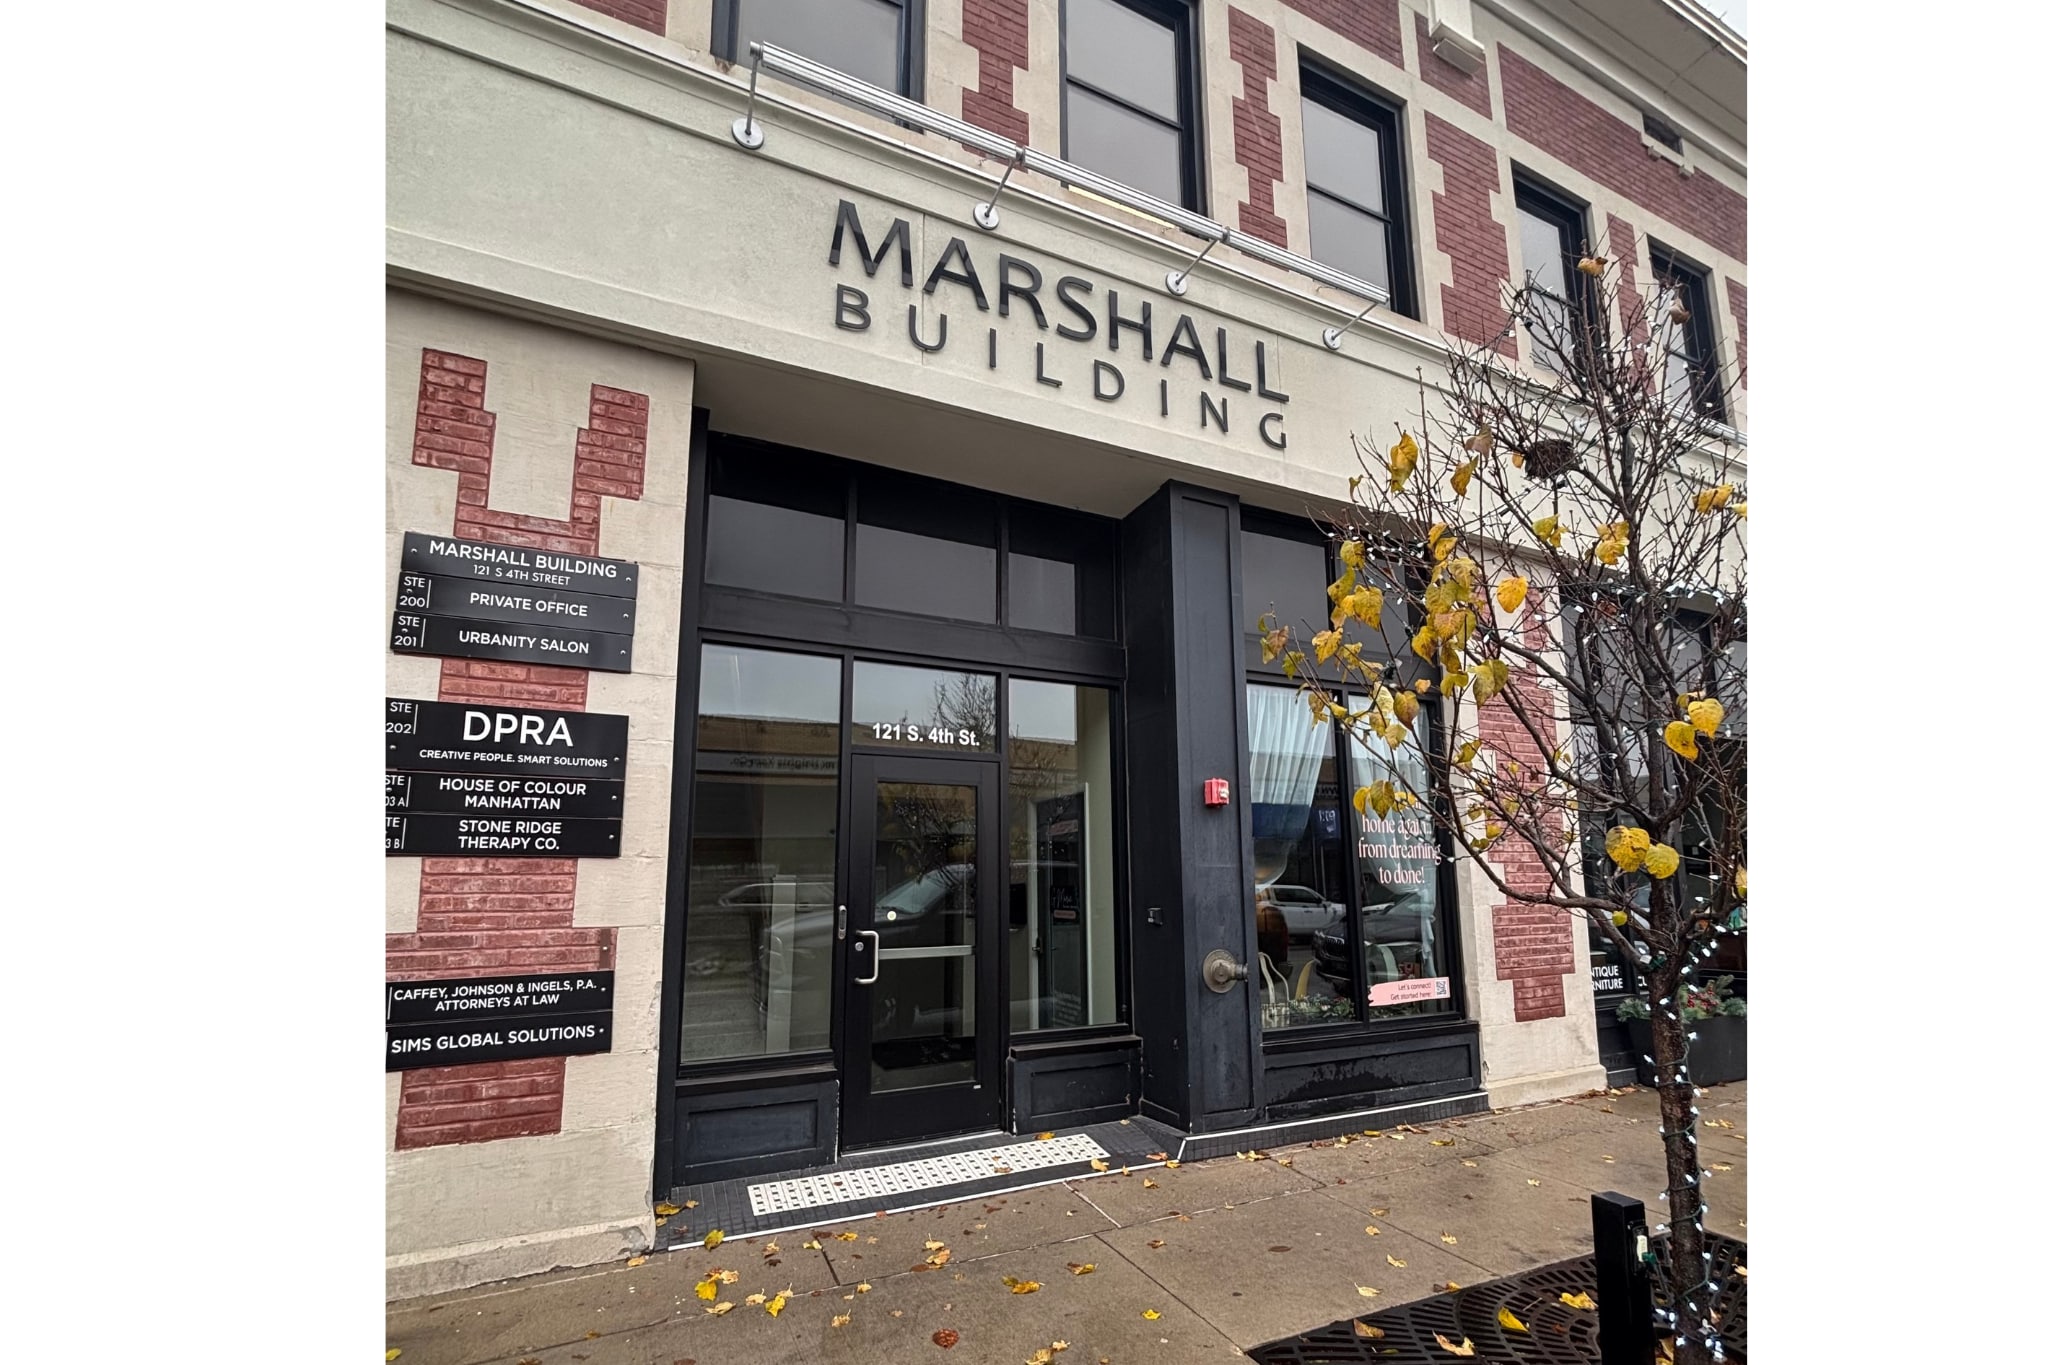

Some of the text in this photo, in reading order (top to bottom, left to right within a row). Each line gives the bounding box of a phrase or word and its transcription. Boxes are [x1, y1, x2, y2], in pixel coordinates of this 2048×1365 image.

[828, 198, 1289, 402] MARSHALL
[835, 283, 1287, 449] BUILDING
[429, 540, 617, 578] MARSHALL BUILDING
[404, 576, 425, 588] STE
[473, 565, 571, 585] 121 S 4TH STREET
[400, 596, 425, 608] 200
[470, 593, 587, 616] PRIVATE OFFICE
[398, 615, 420, 627] STE
[394, 635, 416, 647] 201
[459, 631, 589, 654] URBANITY SALON
[390, 702, 412, 713] STE
[386, 723, 412, 734] 202
[463, 711, 574, 746] DPRA
[873, 723, 979, 746] 121 S. 4th St.
[419, 750, 608, 768] CREATIVE PEOPLE. SMART SOLUTIONS
[386, 774, 405, 786] STE
[440, 778, 586, 795] HOUSE OF COLOUR
[386, 796, 405, 807] 03 A
[464, 795, 561, 810] MANHATTAN
[459, 820, 562, 834] STONE RIDGE
[1362, 814, 1395, 833] home
[394, 839, 400, 848] B
[458, 836, 560, 850] THERAPY CO.
[1358, 837, 1441, 865] from dreaming
[1379, 863, 1424, 884] to done!
[1590, 965, 1619, 977] NTIQUE
[394, 979, 597, 1000] CAFFEY, JOHNSON & INGELS, P.A.
[435, 994, 560, 1011] ATTORNEYS AT LAW
[391, 1025, 595, 1053] SIMS GLOBAL SOLUTIONS
